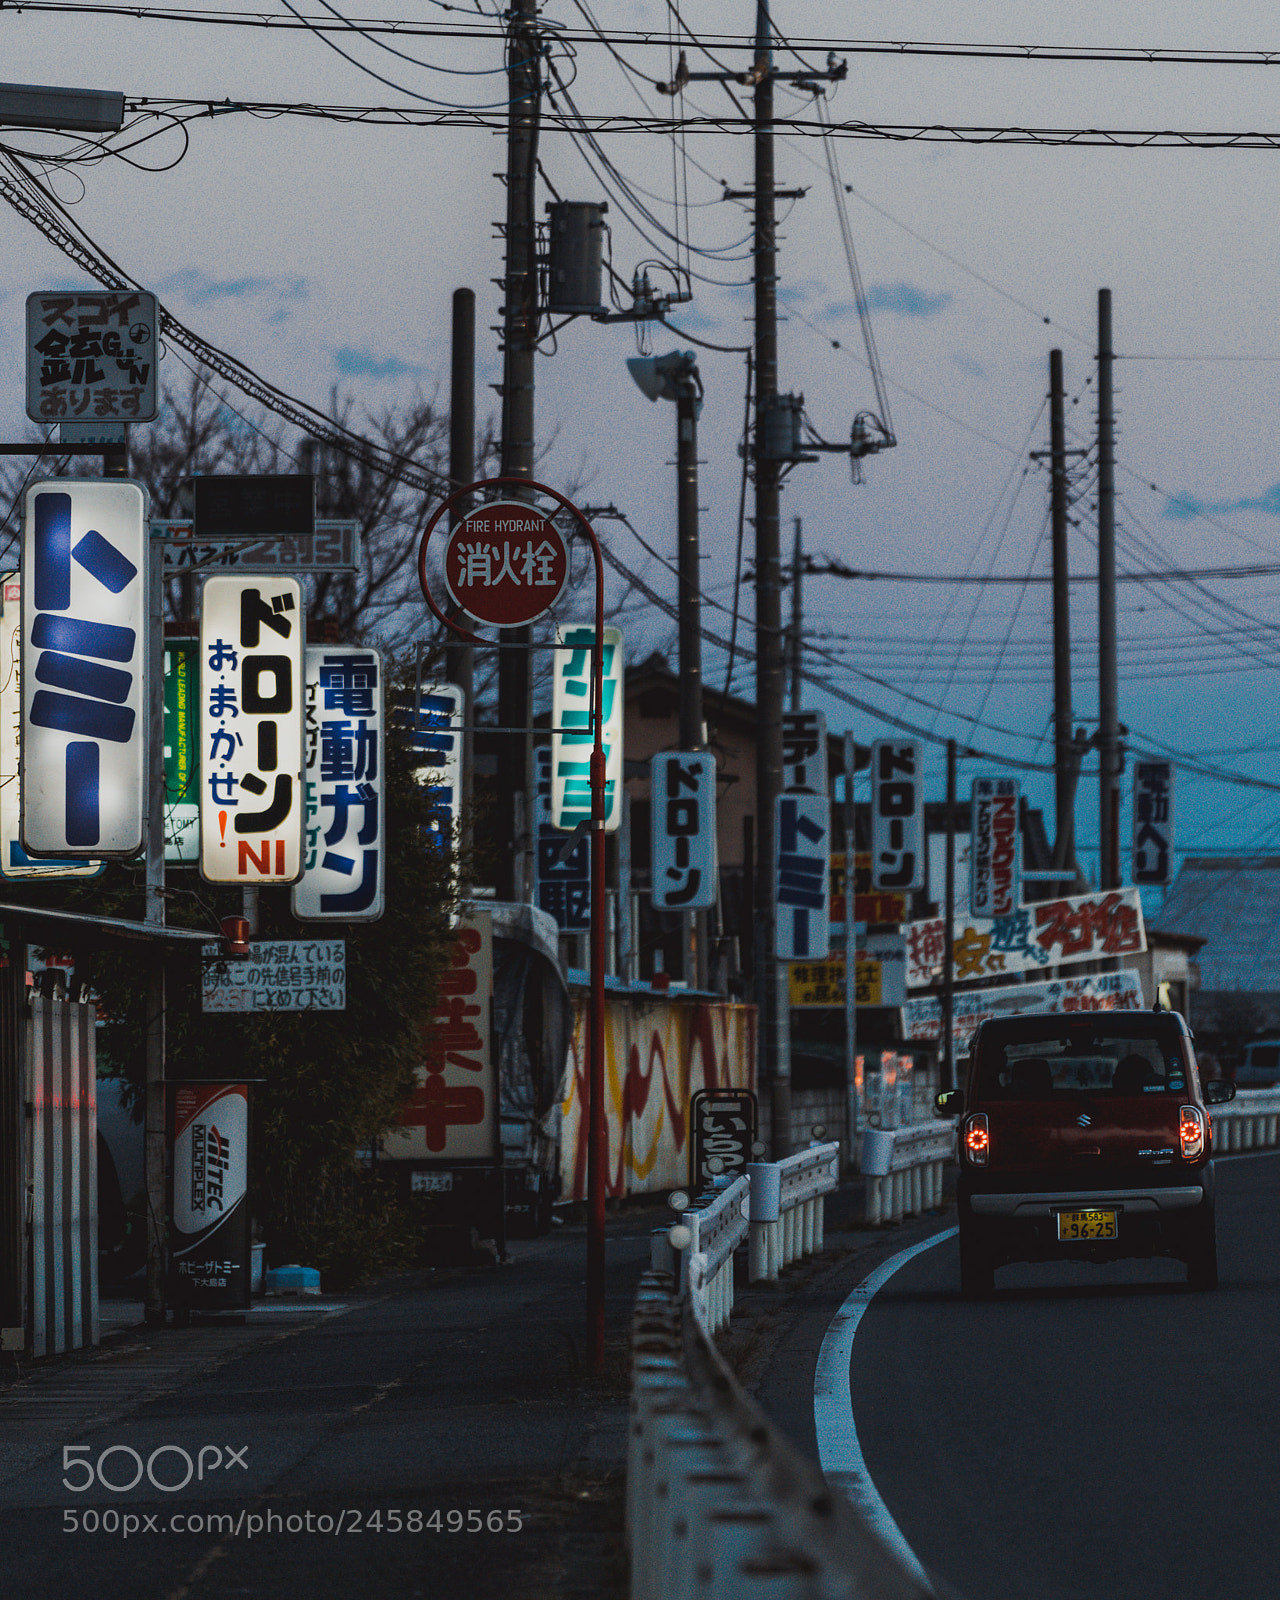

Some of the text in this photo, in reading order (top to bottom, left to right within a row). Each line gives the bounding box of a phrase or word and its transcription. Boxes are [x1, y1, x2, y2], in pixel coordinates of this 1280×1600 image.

[41, 294, 140, 327] スゴイ
[40, 386, 145, 416] あります
[465, 518, 546, 532] FIRE HYDRANT
[457, 541, 557, 587] 消火栓
[30, 493, 137, 846] トミー
[177, 679, 187, 710] LEADING
[234, 588, 295, 834] ドローン
[177, 711, 187, 771] MANUFACTURER
[320, 655, 379, 913] 電動ガン
[667, 759, 704, 906] ドローン
[879, 745, 915, 887] ドローン
[778, 800, 827, 957] トミー
[794, 965, 879, 984] 修理技士
[192, 1125, 206, 1212] MULTIPLEX
[1071, 1222, 1114, 1238] 96-25
[1088, 1213, 1104, 1222] 583
[178, 1261, 241, 1276] ホビーザトミー
[192, 1277, 228, 1288] 下大島店
